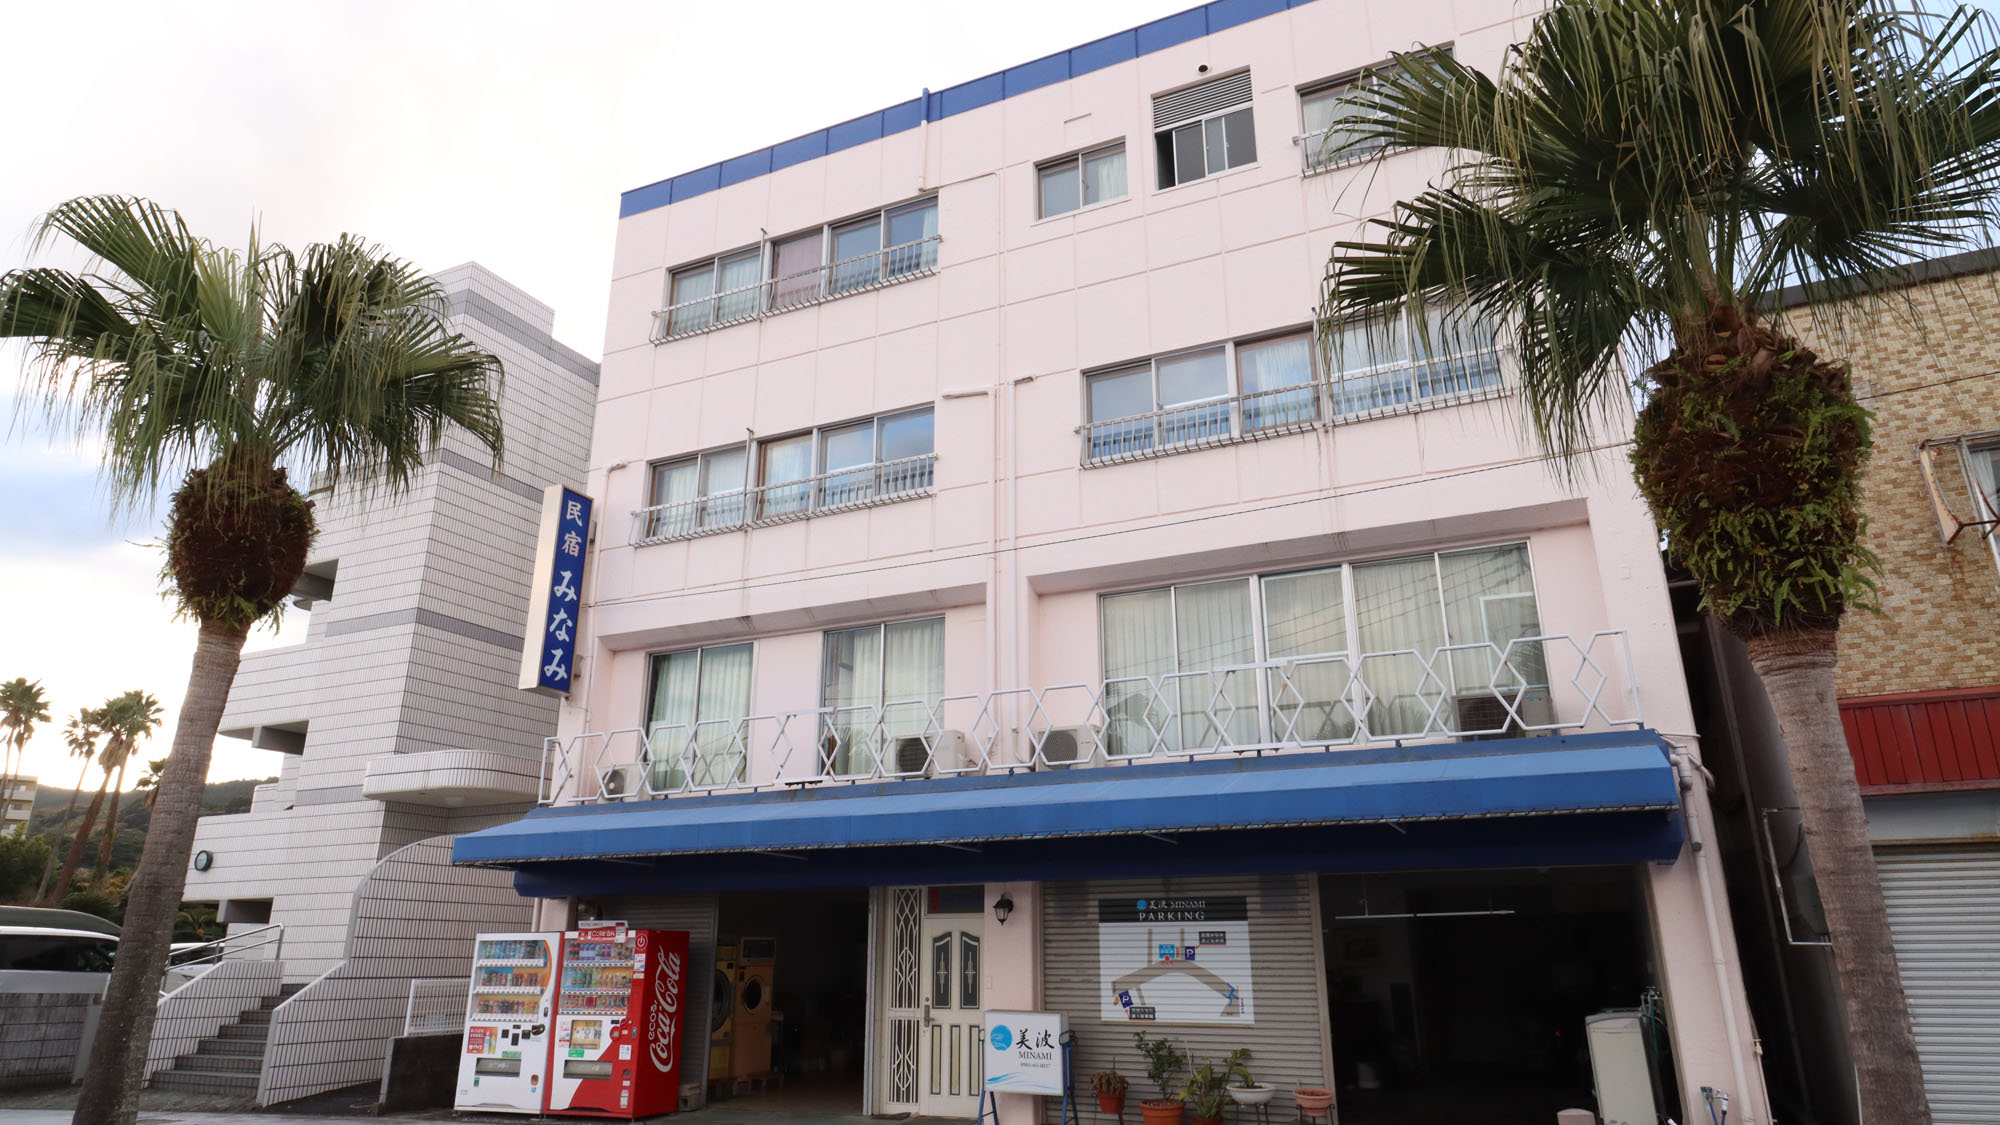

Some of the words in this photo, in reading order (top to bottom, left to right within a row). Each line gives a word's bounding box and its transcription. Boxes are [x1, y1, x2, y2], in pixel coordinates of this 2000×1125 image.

[561, 500, 583, 557] 民宿
[543, 570, 578, 681] みなみ
[1170, 900, 1206, 909] MINAMI
[1139, 911, 1205, 921] PARKING
[649, 944, 681, 1073] Coca-Cola
[1016, 1028, 1055, 1050] 美波
[1018, 1050, 1053, 1061] MINAMI
